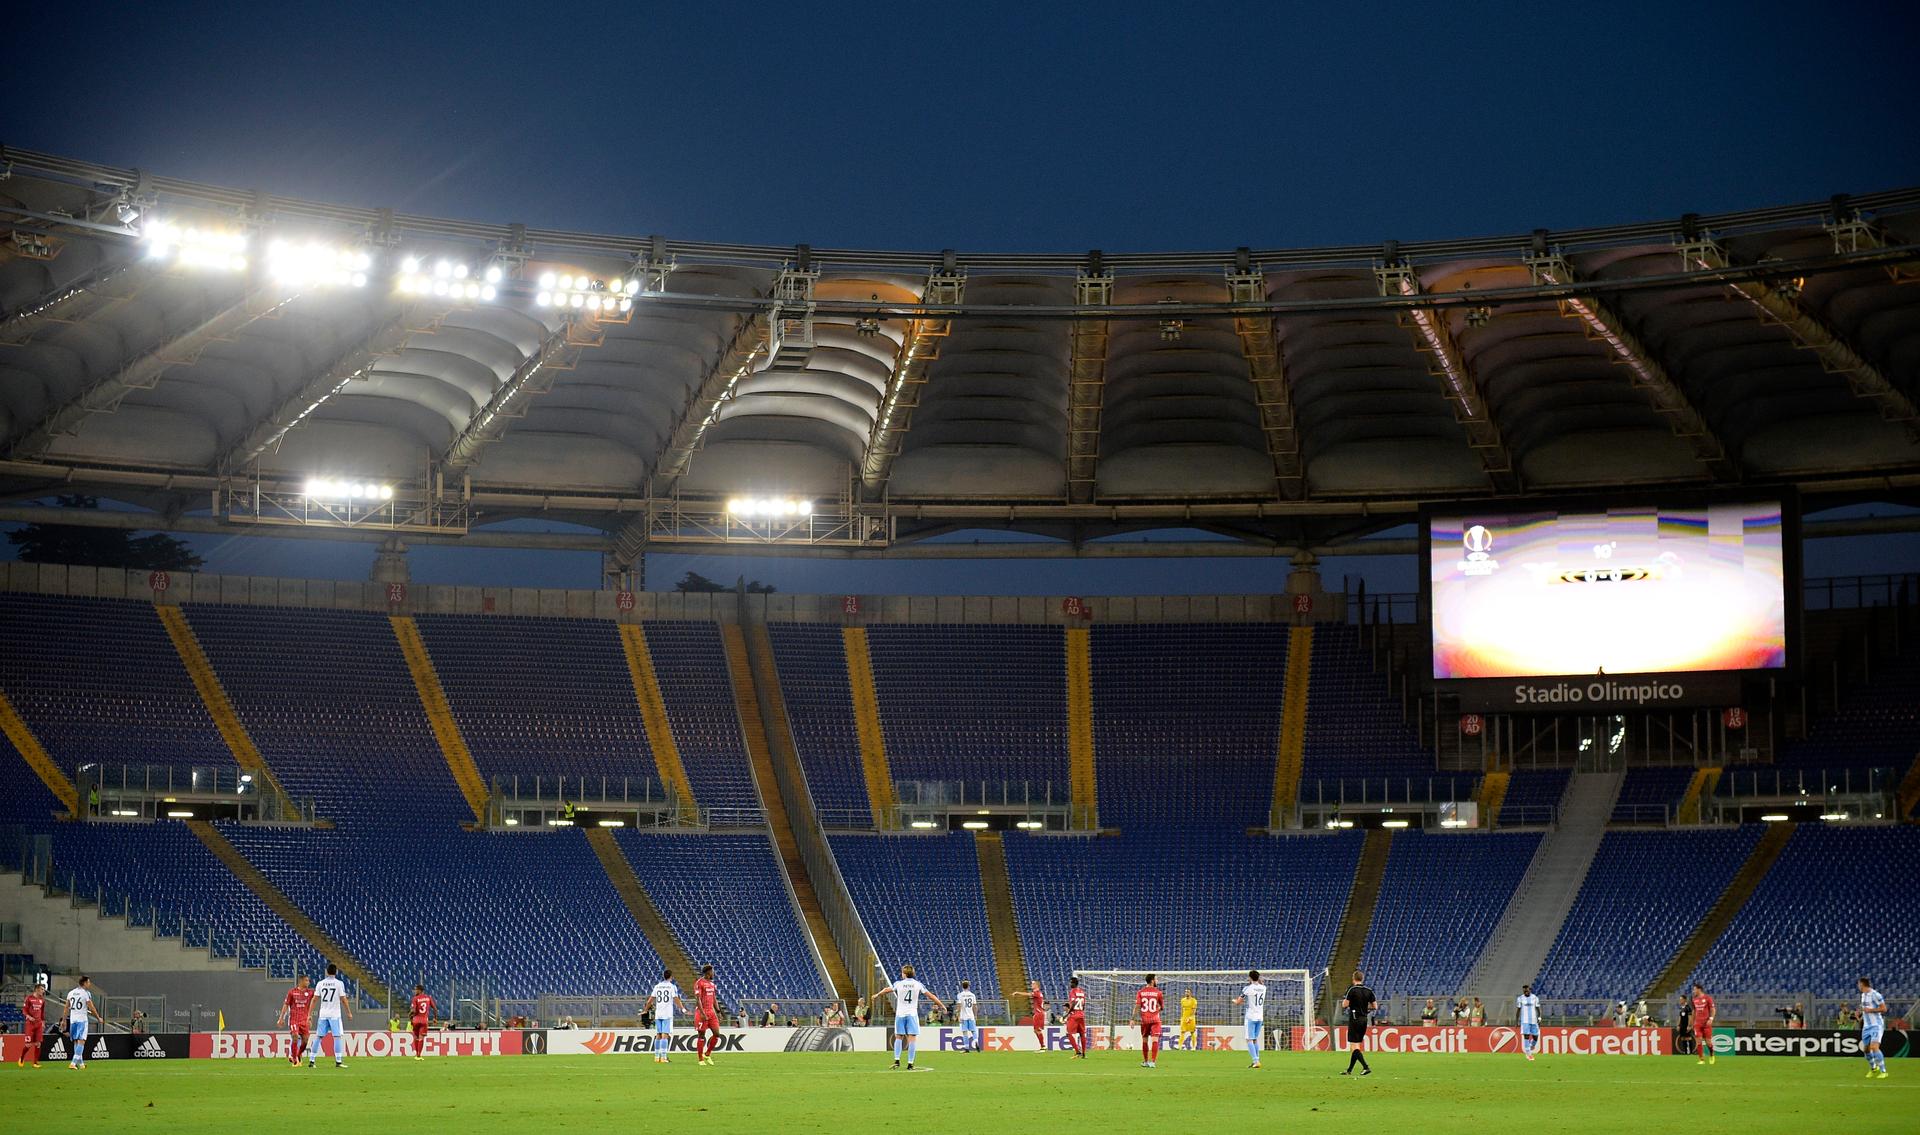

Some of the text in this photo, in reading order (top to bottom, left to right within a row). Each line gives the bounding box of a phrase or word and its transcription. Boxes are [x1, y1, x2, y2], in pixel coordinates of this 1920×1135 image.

[154, 581, 166, 590] AD
[391, 584, 401, 592] 22
[390, 593, 402, 601] AS
[621, 592, 631, 600] 22
[847, 596, 856, 604] 21
[1298, 596, 1308, 604] 20
[620, 601, 632, 609] AD
[1068, 598, 1078, 606] 21
[846, 605, 857, 613] AS
[1067, 606, 1079, 614] AD
[1297, 604, 1308, 612] AS
[1515, 680, 1684, 705] Stadio Olimpico
[1729, 708, 1740, 717] 19
[1467, 715, 1478, 723] 20
[1728, 718, 1741, 727] AS
[1466, 724, 1480, 733] AD
[321, 988, 336, 1002] 27
[656, 990, 669, 1003] 88
[904, 990, 912, 1004] 4
[1254, 993, 1264, 1006] 16
[70, 997, 83, 1010] 26
[419, 1002, 427, 1014] 3
[1141, 998, 1157, 1013] 30
[341, 1032, 501, 1057] MORETTI
[48, 1051, 68, 1060] adidas
[91, 1051, 110, 1059] adidas
[133, 1049, 166, 1058] adidas
